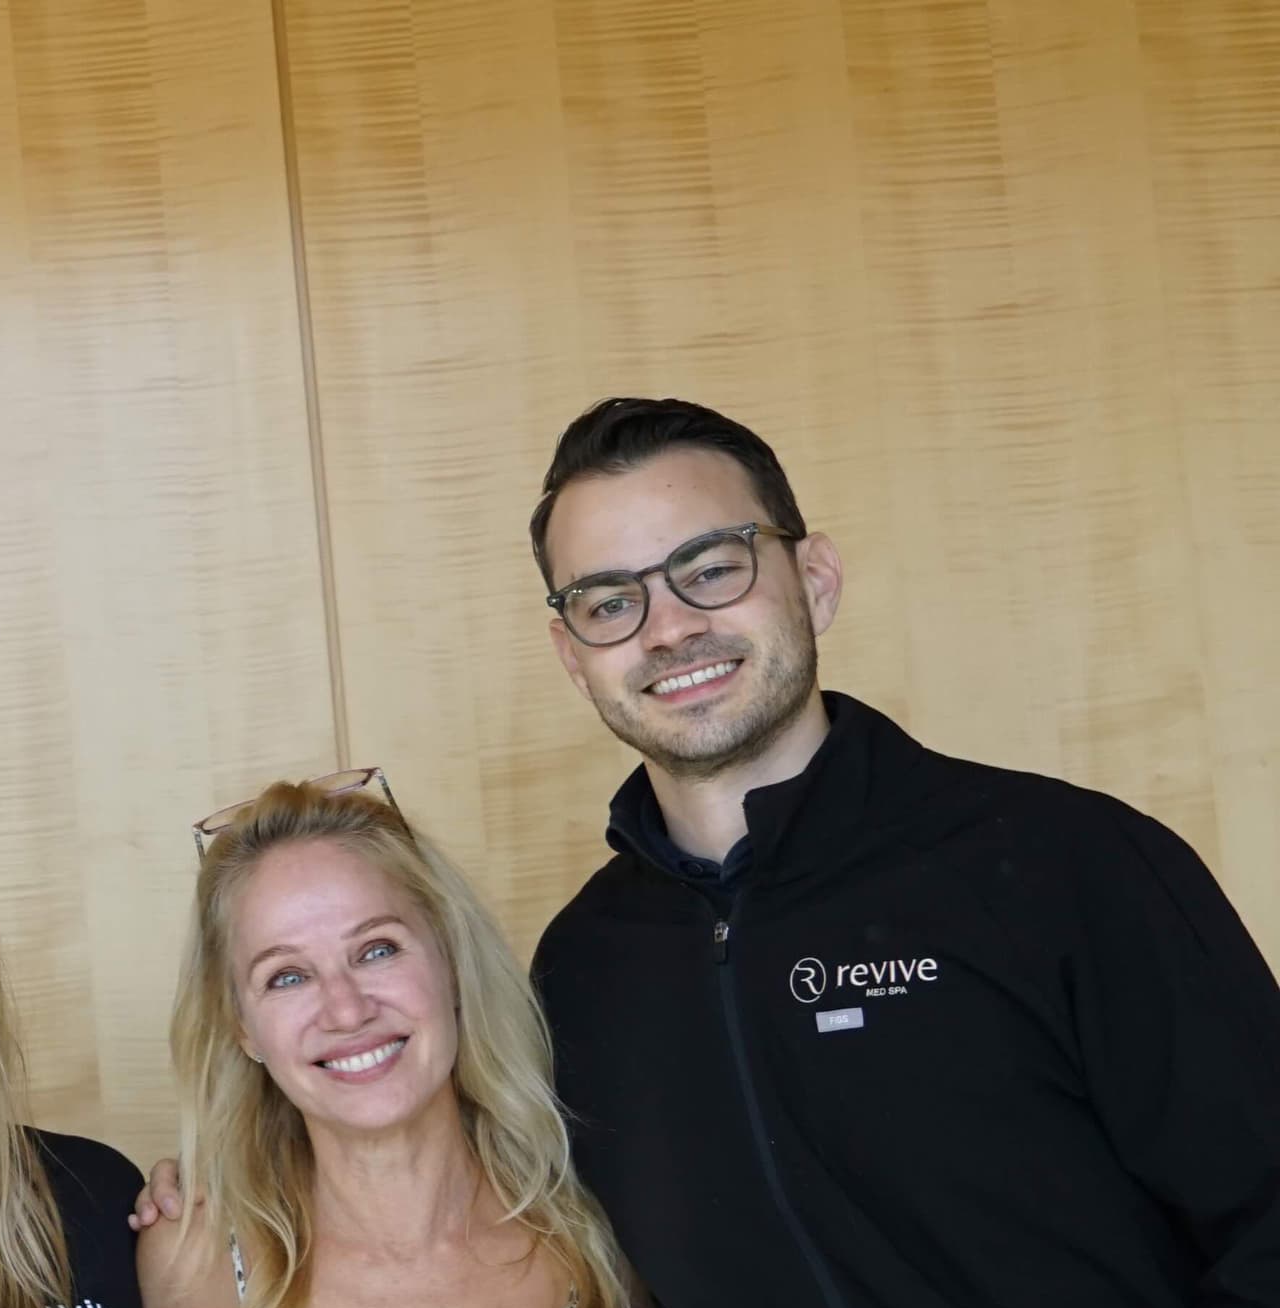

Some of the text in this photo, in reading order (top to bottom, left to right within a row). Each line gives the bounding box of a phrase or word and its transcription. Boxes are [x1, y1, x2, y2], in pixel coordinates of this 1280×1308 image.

[836, 957, 938, 988] revive
[866, 985, 908, 998] MED SPA
